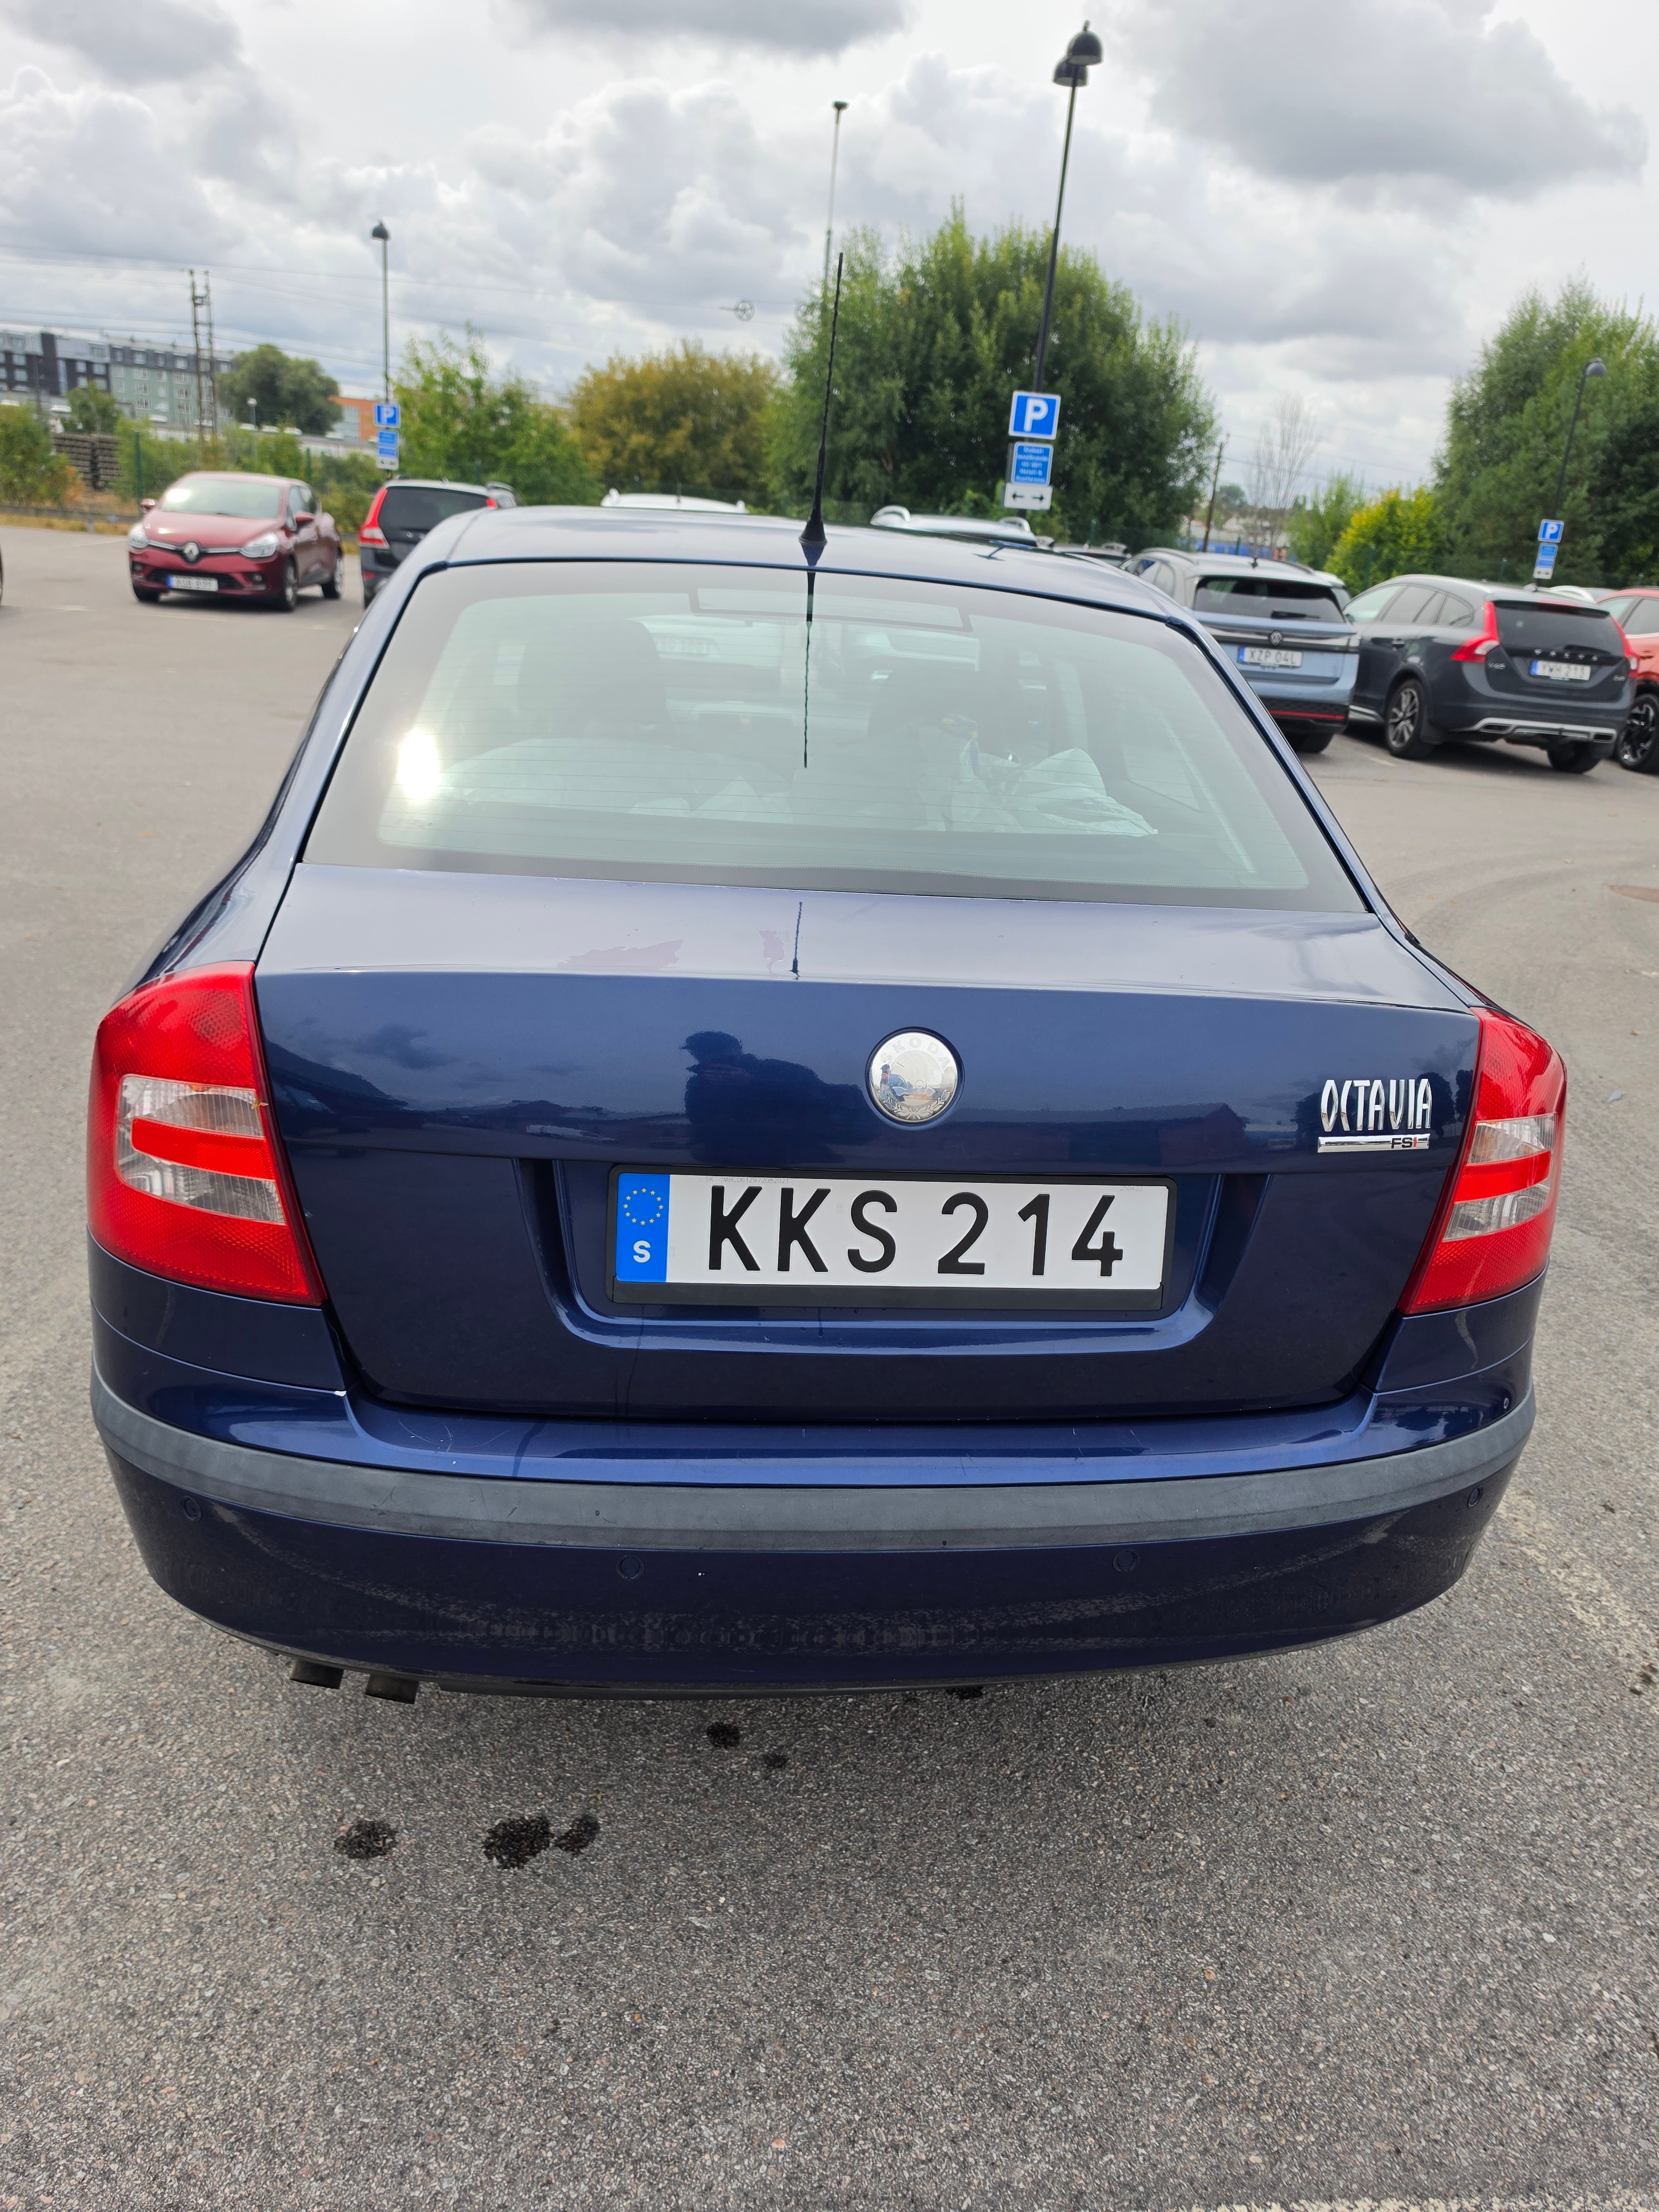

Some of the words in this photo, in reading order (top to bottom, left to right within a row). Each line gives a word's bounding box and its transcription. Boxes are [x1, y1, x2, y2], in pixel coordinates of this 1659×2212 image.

[381, 406, 395, 425] P
[1024, 398, 1048, 432] P
[1545, 523, 1558, 539] P
[1249, 649, 1271, 662] XZP
[1321, 1078, 1432, 1132] OCTAVIA
[1391, 1136, 1417, 1149] FSI
[708, 1185, 898, 1273] KKS
[937, 1192, 1123, 1277] 214
[633, 1240, 651, 1263] S
